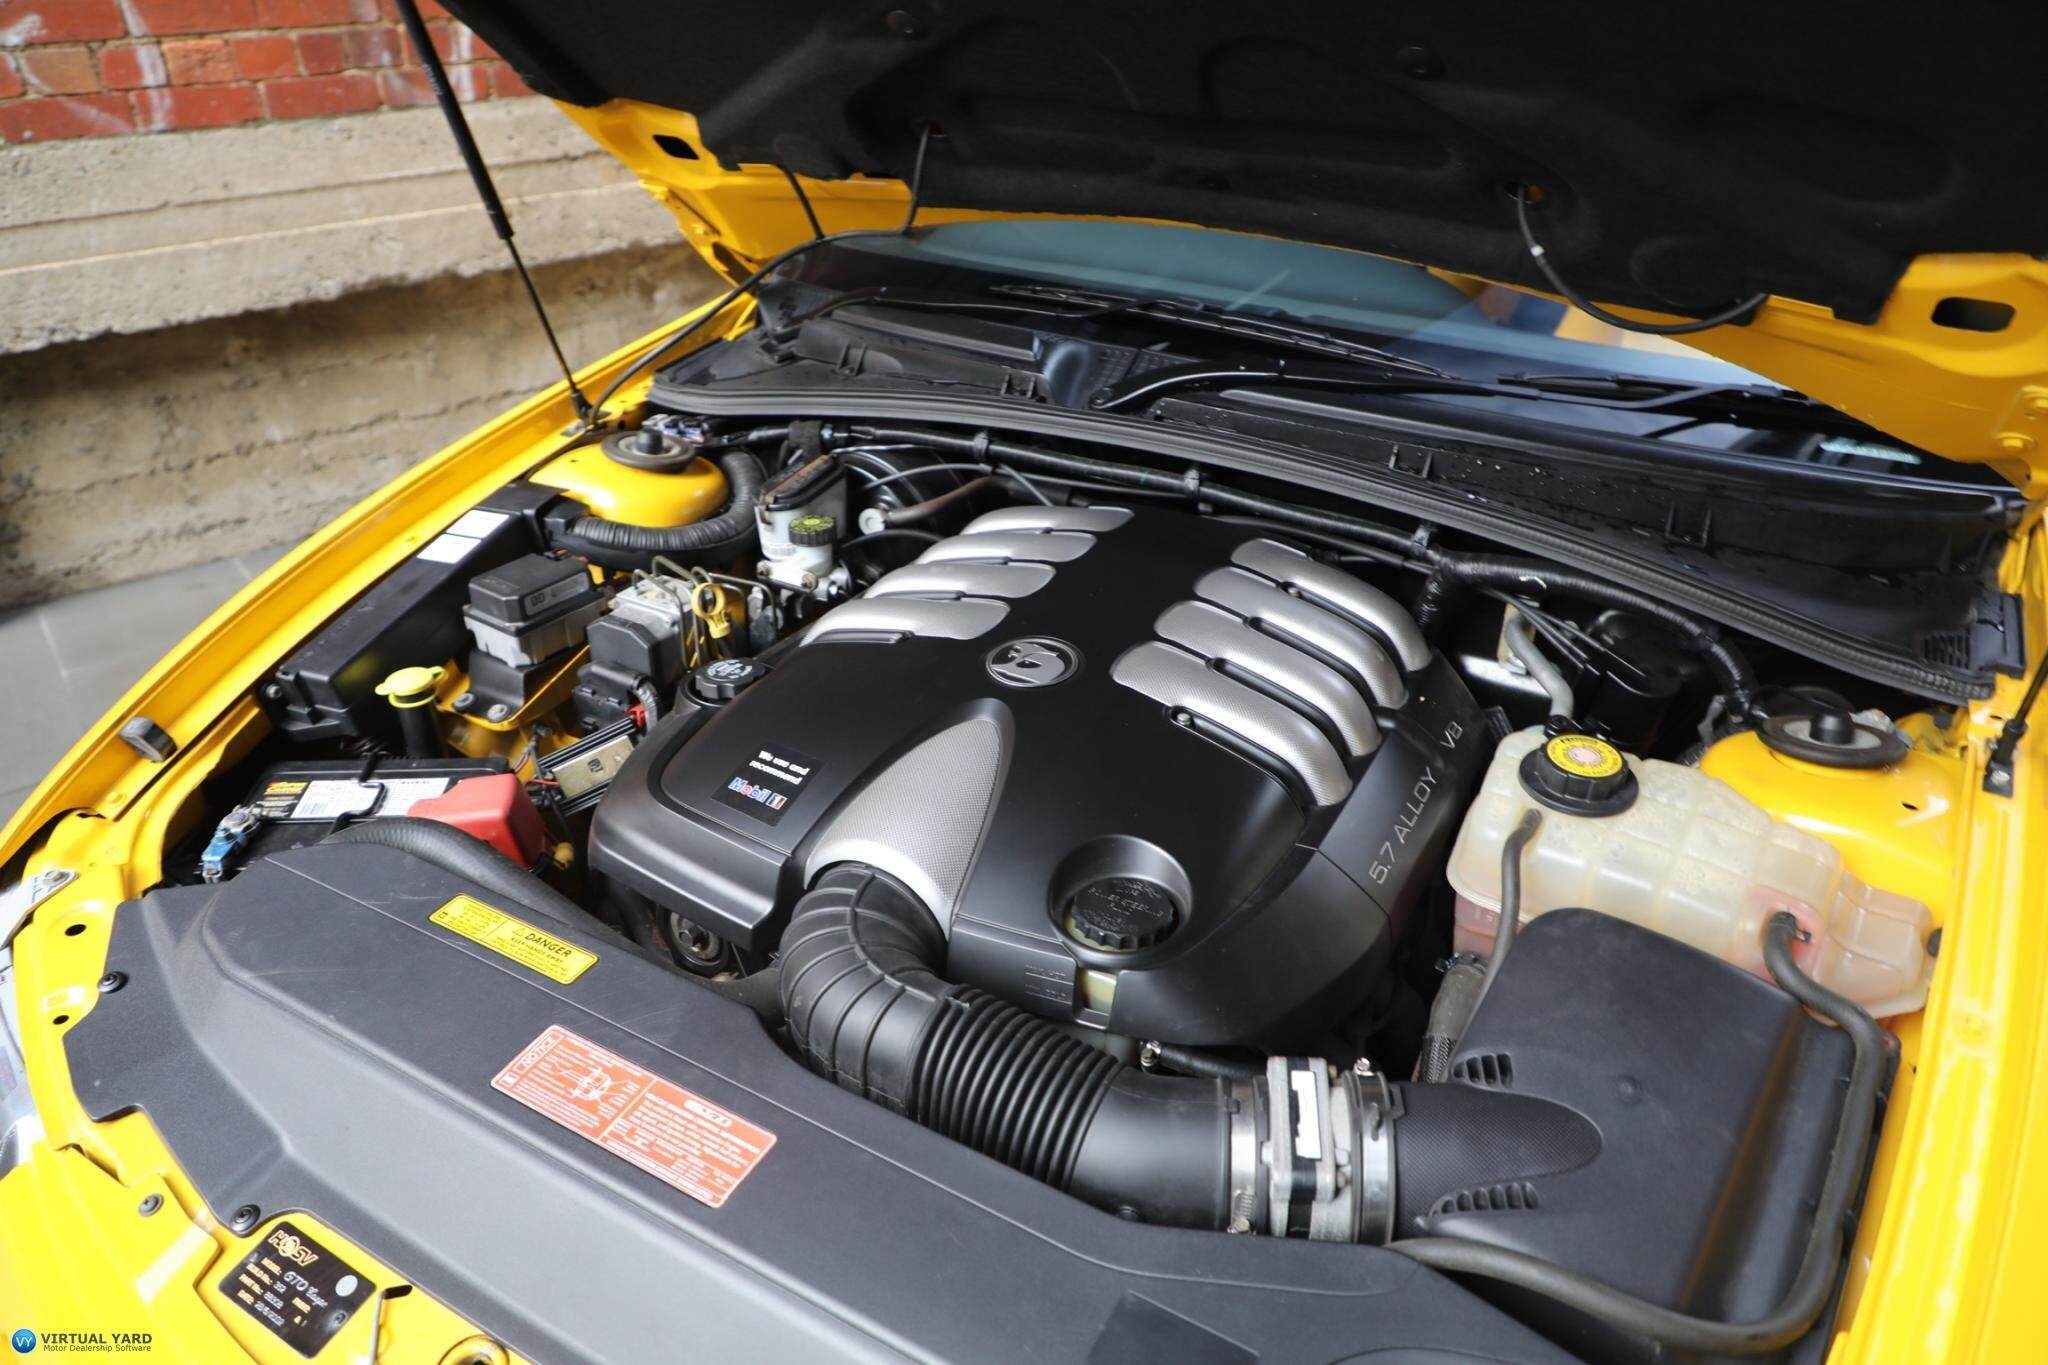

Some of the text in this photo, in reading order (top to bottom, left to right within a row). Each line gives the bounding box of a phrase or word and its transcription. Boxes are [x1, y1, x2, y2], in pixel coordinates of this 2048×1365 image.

[749, 760, 803, 785] recommend
[758, 750, 810, 776] We use and
[728, 776, 788, 810] Mobil 1
[1368, 721, 1463, 884] 5.7 ALLOY V8
[525, 932, 573, 957] DANGER
[522, 1034, 556, 1066] NOTICE
[283, 1271, 309, 1291] GTO
